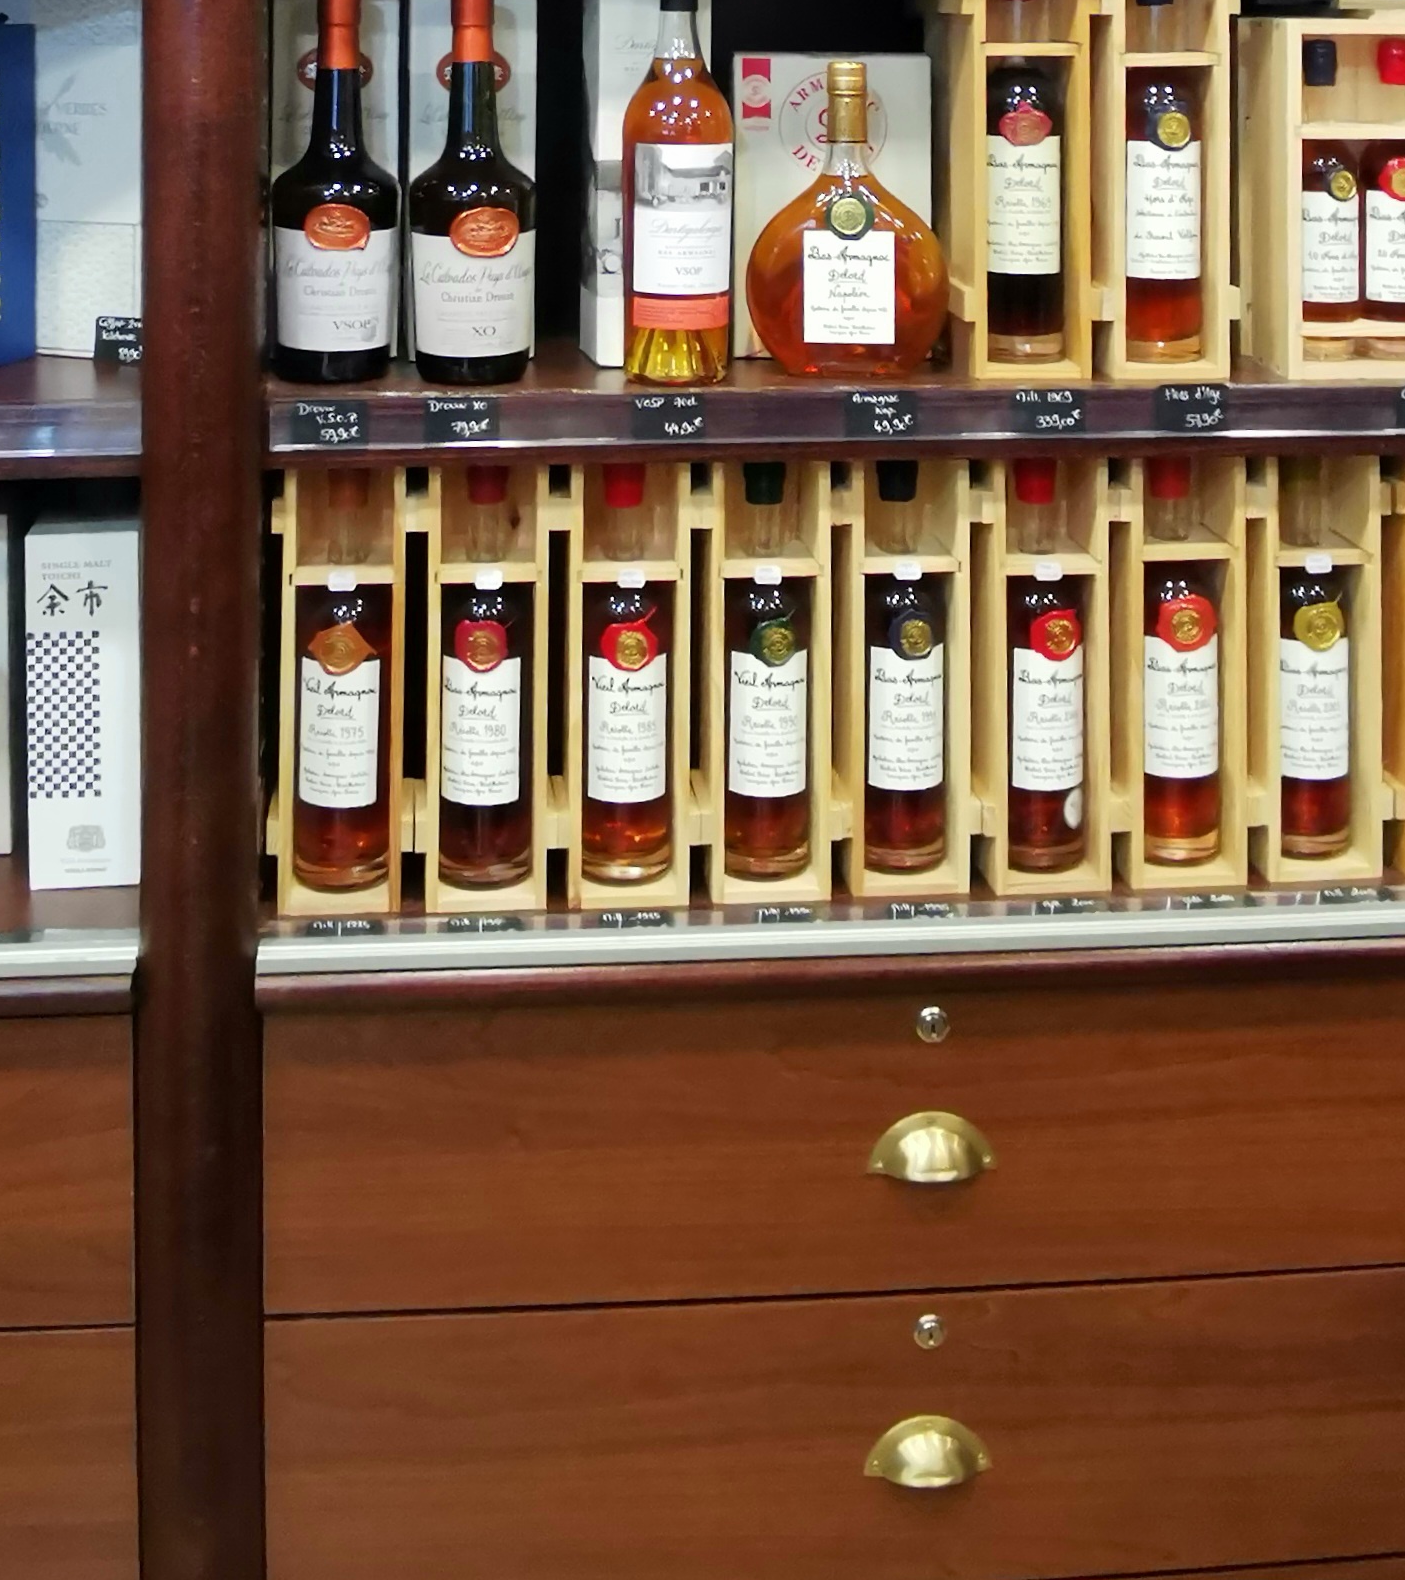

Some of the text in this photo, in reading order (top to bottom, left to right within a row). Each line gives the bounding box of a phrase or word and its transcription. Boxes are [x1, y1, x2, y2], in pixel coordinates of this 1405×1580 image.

[675, 266, 703, 277] VSOP
[332, 319, 373, 332] VSOP
[471, 324, 497, 337] XO
[41, 559, 112, 570] SINGLE MALT
[36, 580, 109, 617] 余市
[341, 726, 365, 738] 1975
[484, 724, 507, 737] 1980
